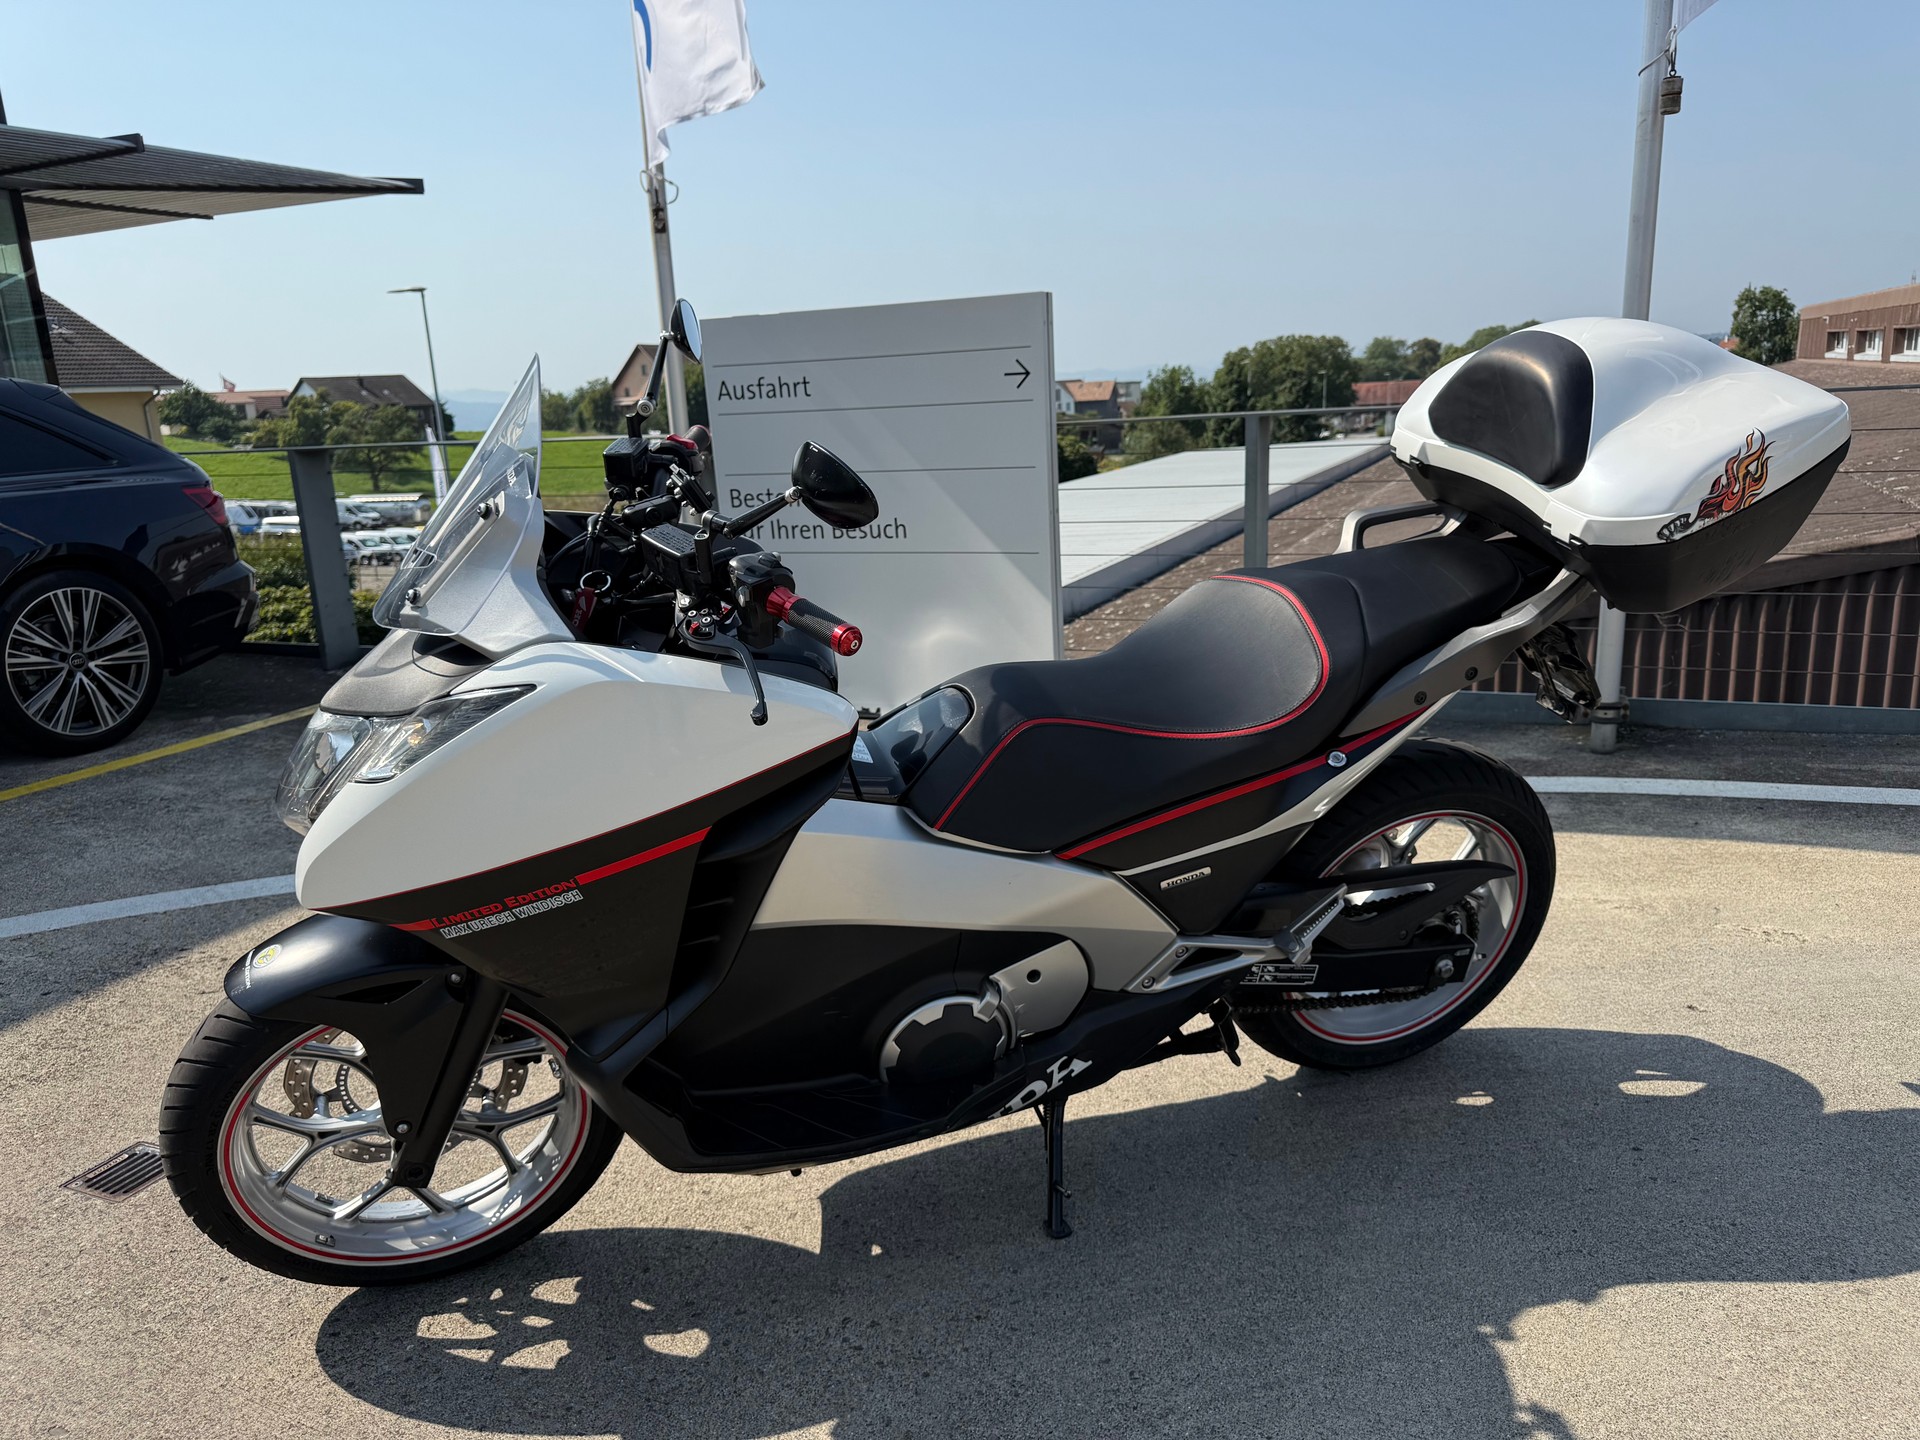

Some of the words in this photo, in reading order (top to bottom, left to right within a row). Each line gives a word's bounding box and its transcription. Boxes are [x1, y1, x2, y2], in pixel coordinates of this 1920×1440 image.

[717, 375, 812, 401] Ausfahrt
[770, 517, 825, 541] Ihren
[1166, 871, 1206, 888] HONDA
[432, 902, 503, 928] LIMITED
[503, 878, 577, 909] EDITION
[440, 921, 472, 940] MAX
[471, 911, 516, 932] URECH
[512, 889, 584, 919] WINDISCH
